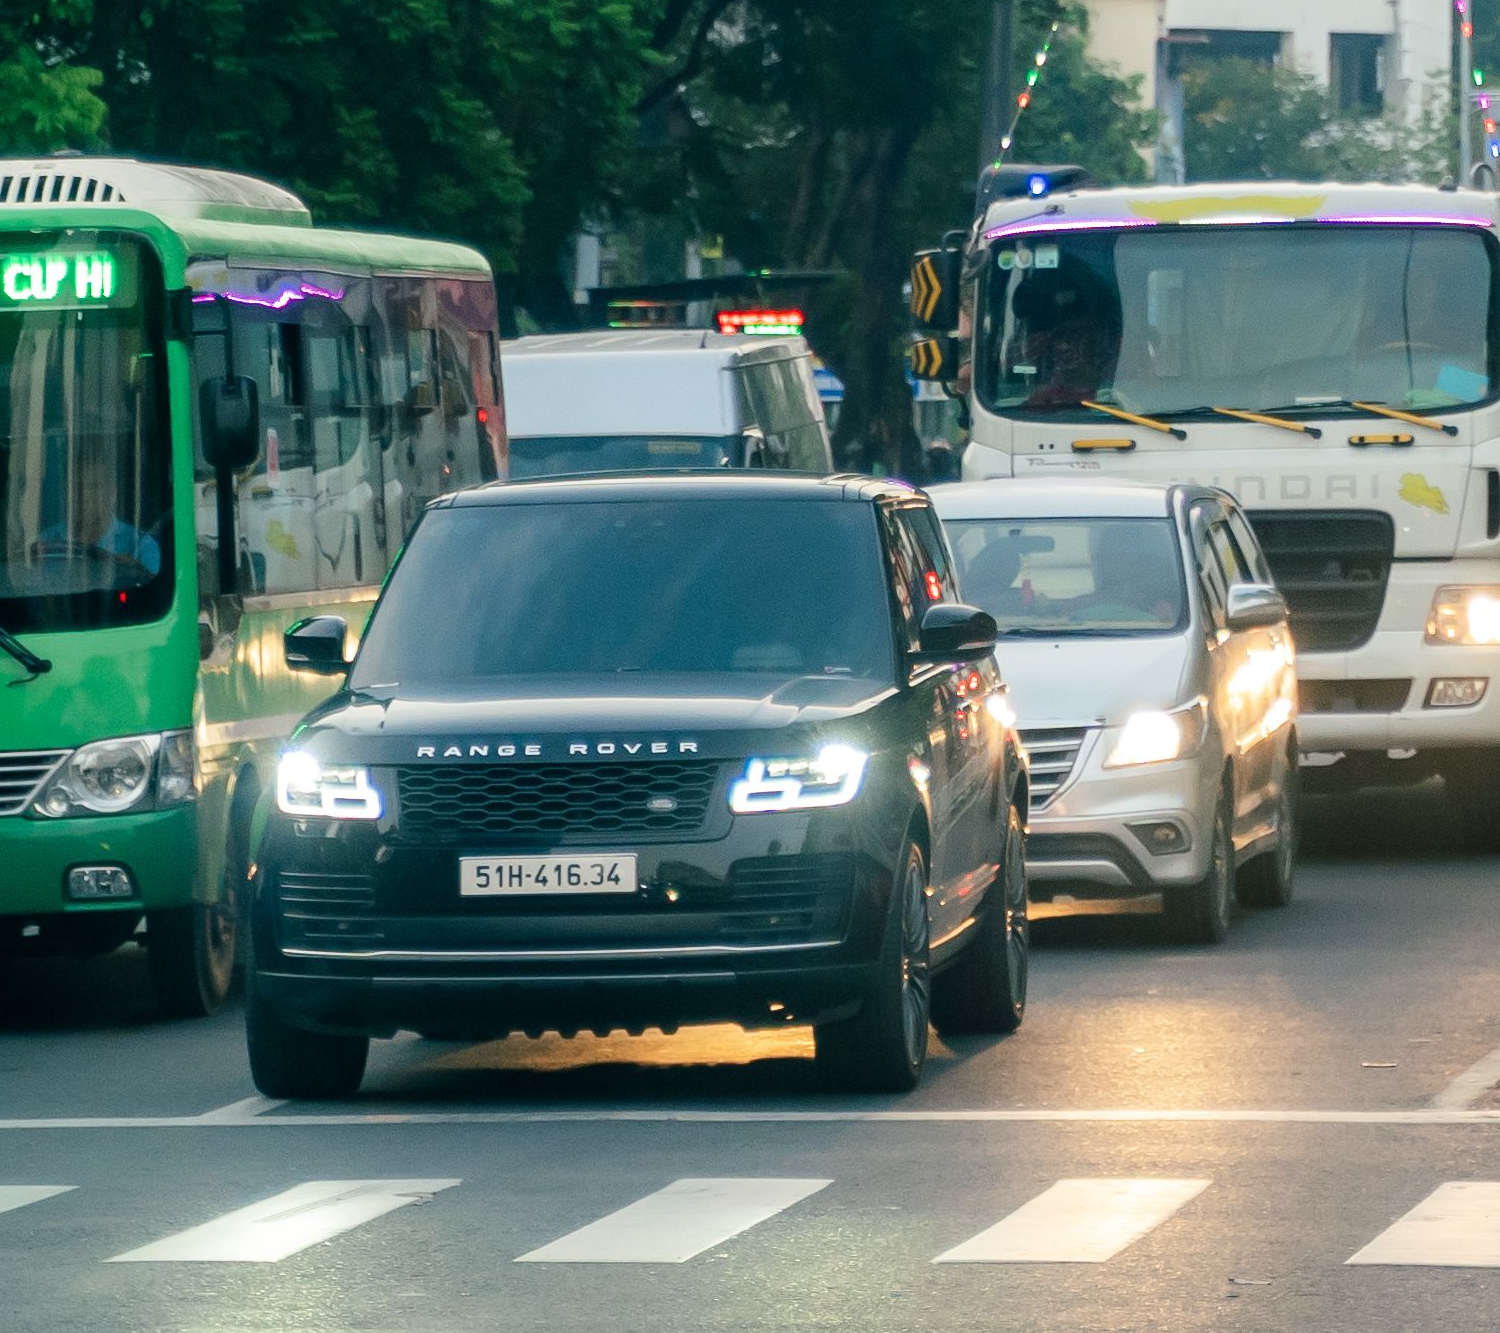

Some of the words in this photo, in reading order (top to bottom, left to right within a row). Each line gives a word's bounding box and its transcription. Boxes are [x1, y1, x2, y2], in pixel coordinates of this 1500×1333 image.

[416, 744, 542, 758] RANGE
[569, 741, 699, 755] ROVER
[475, 862, 621, 889] 51H-416.34
